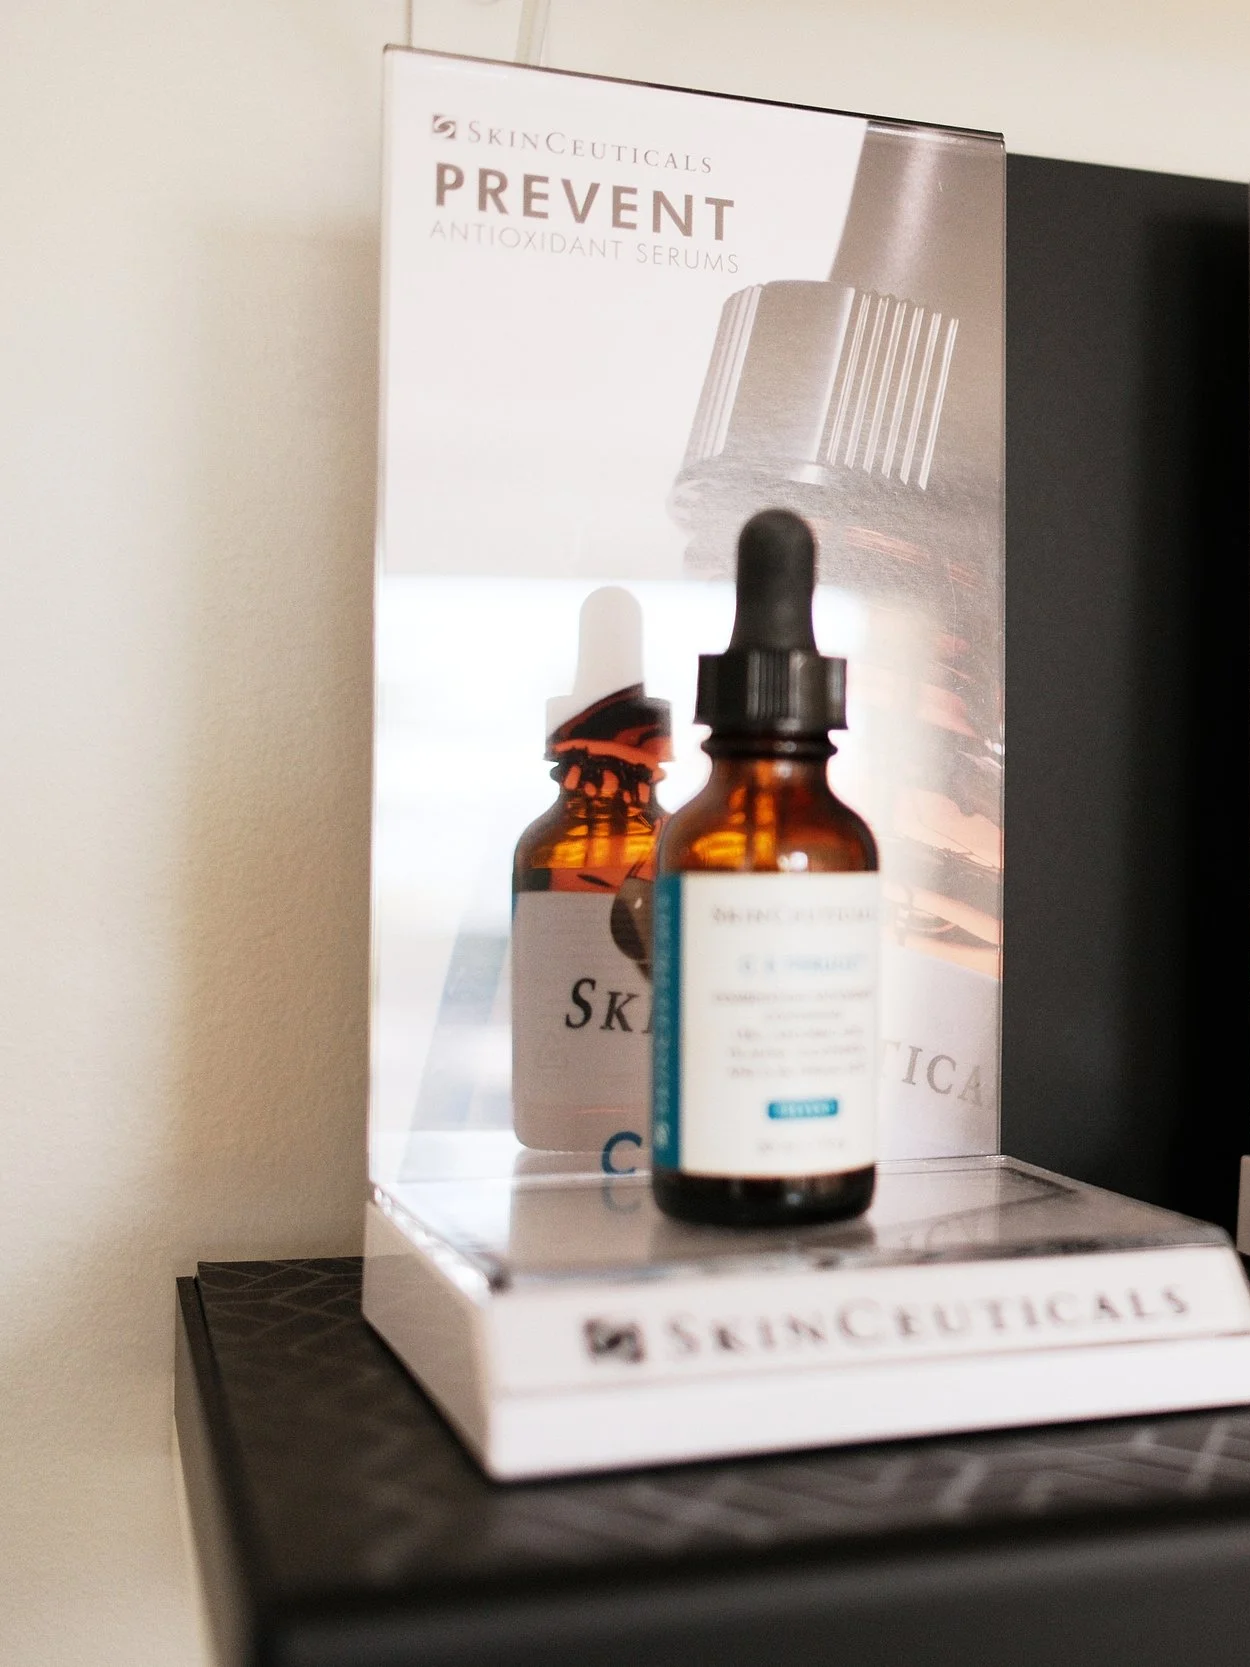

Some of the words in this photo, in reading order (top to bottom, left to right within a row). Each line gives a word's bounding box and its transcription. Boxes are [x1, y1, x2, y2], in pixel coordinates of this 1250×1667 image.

[435, 162, 735, 241] PREVENT
[428, 219, 623, 261] ANTIOXIDANT
[635, 242, 739, 275] SERUMS
